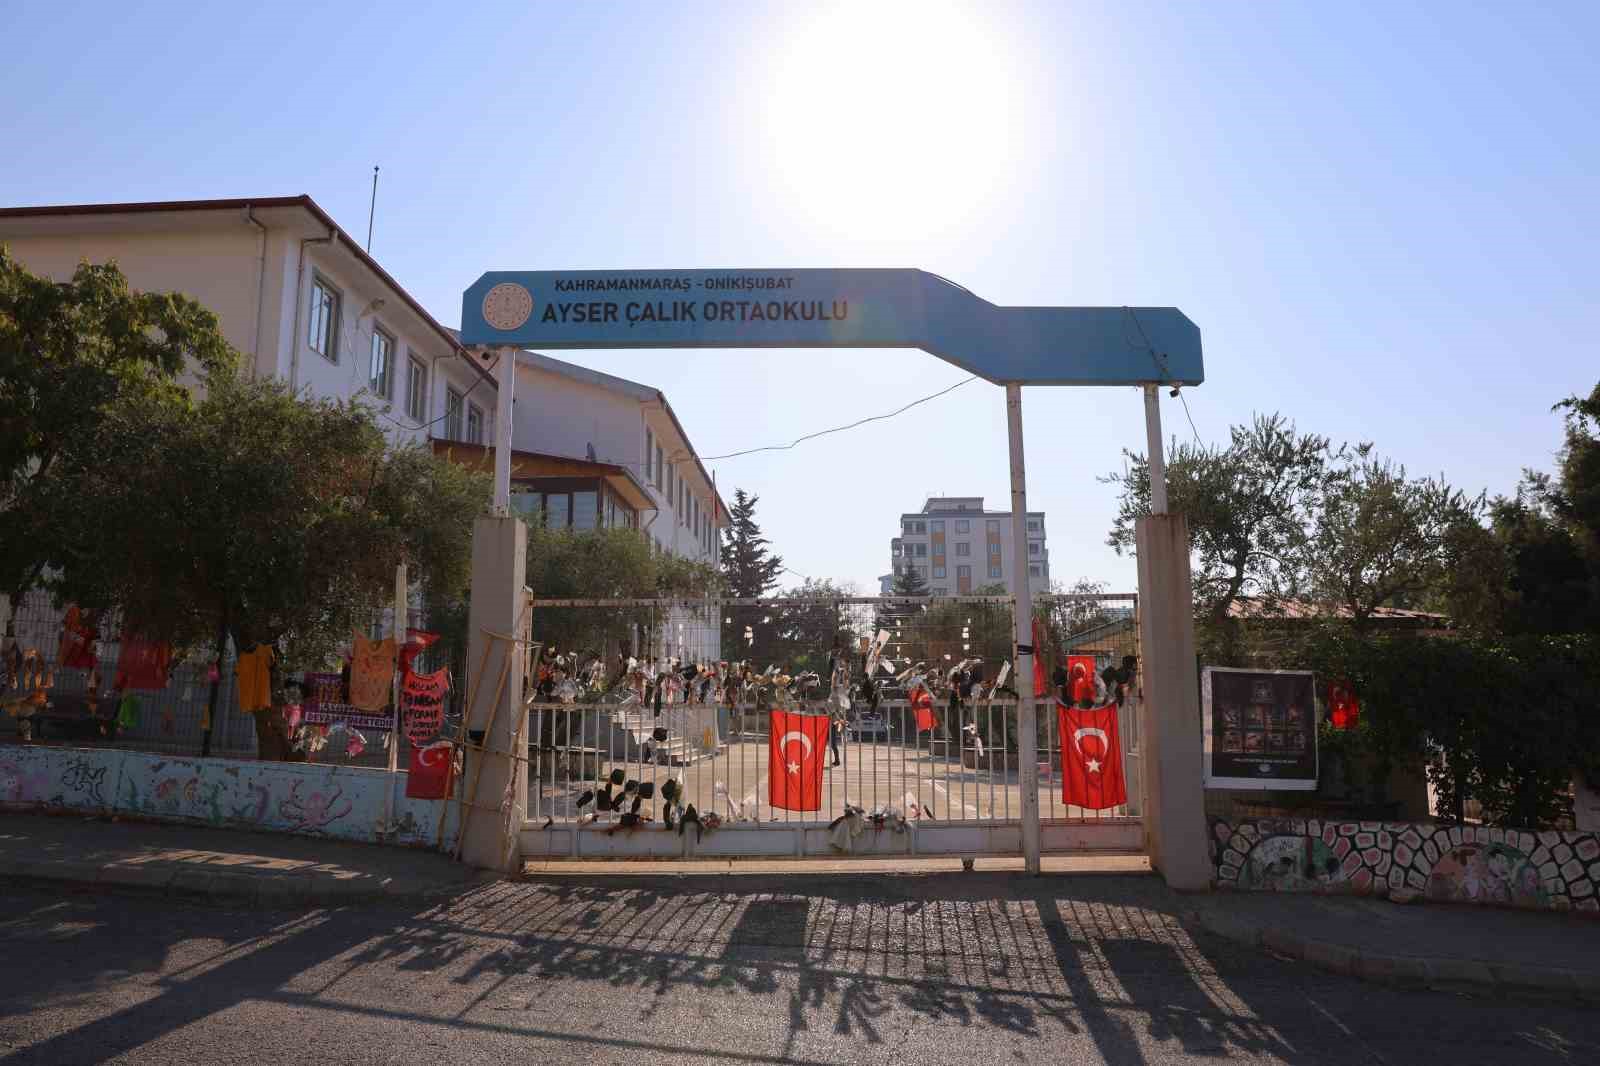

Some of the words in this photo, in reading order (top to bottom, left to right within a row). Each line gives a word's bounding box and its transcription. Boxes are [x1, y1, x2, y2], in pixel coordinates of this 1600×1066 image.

[554, 278, 692, 292] KAHRAMANMARAŞ
[704, 275, 793, 291] ONİKİŞUBAT
[541, 302, 619, 323] AYSER
[625, 301, 697, 328] ÇALIK
[703, 300, 848, 321] ORTAOKULU
